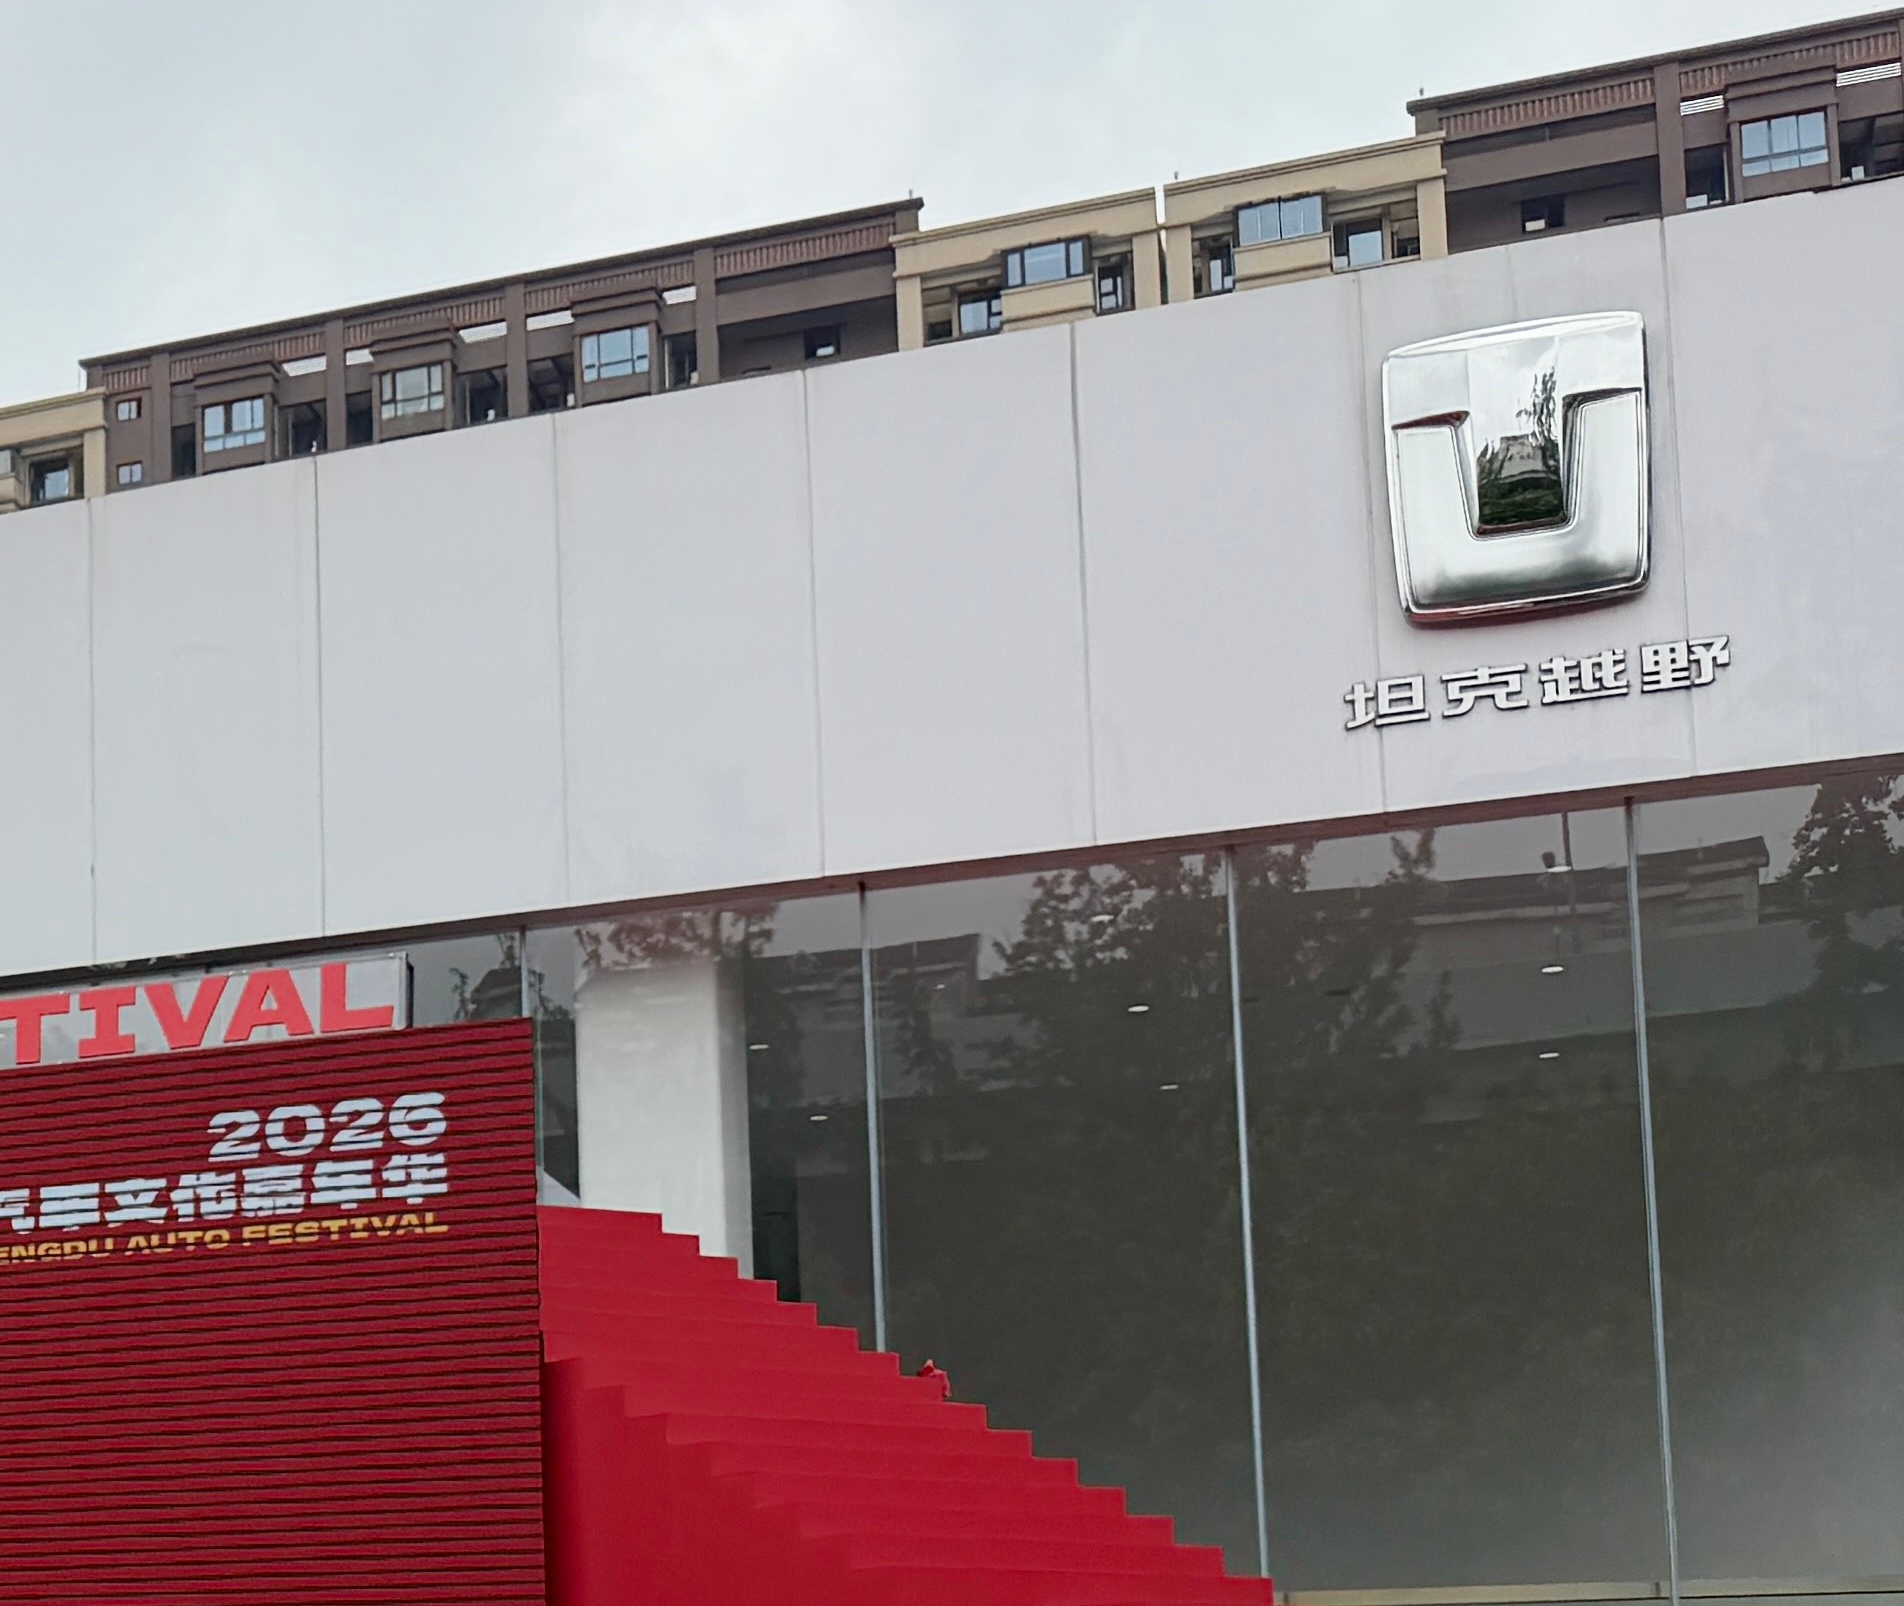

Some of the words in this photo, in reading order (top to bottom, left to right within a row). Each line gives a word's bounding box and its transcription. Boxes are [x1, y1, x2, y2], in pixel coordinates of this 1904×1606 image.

[1344, 634, 1731, 731] 坦克越野
[207, 1092, 446, 1162] 2026
[123, 1226, 232, 1257] AUTO
[241, 1211, 449, 1248] FESTIVAL
